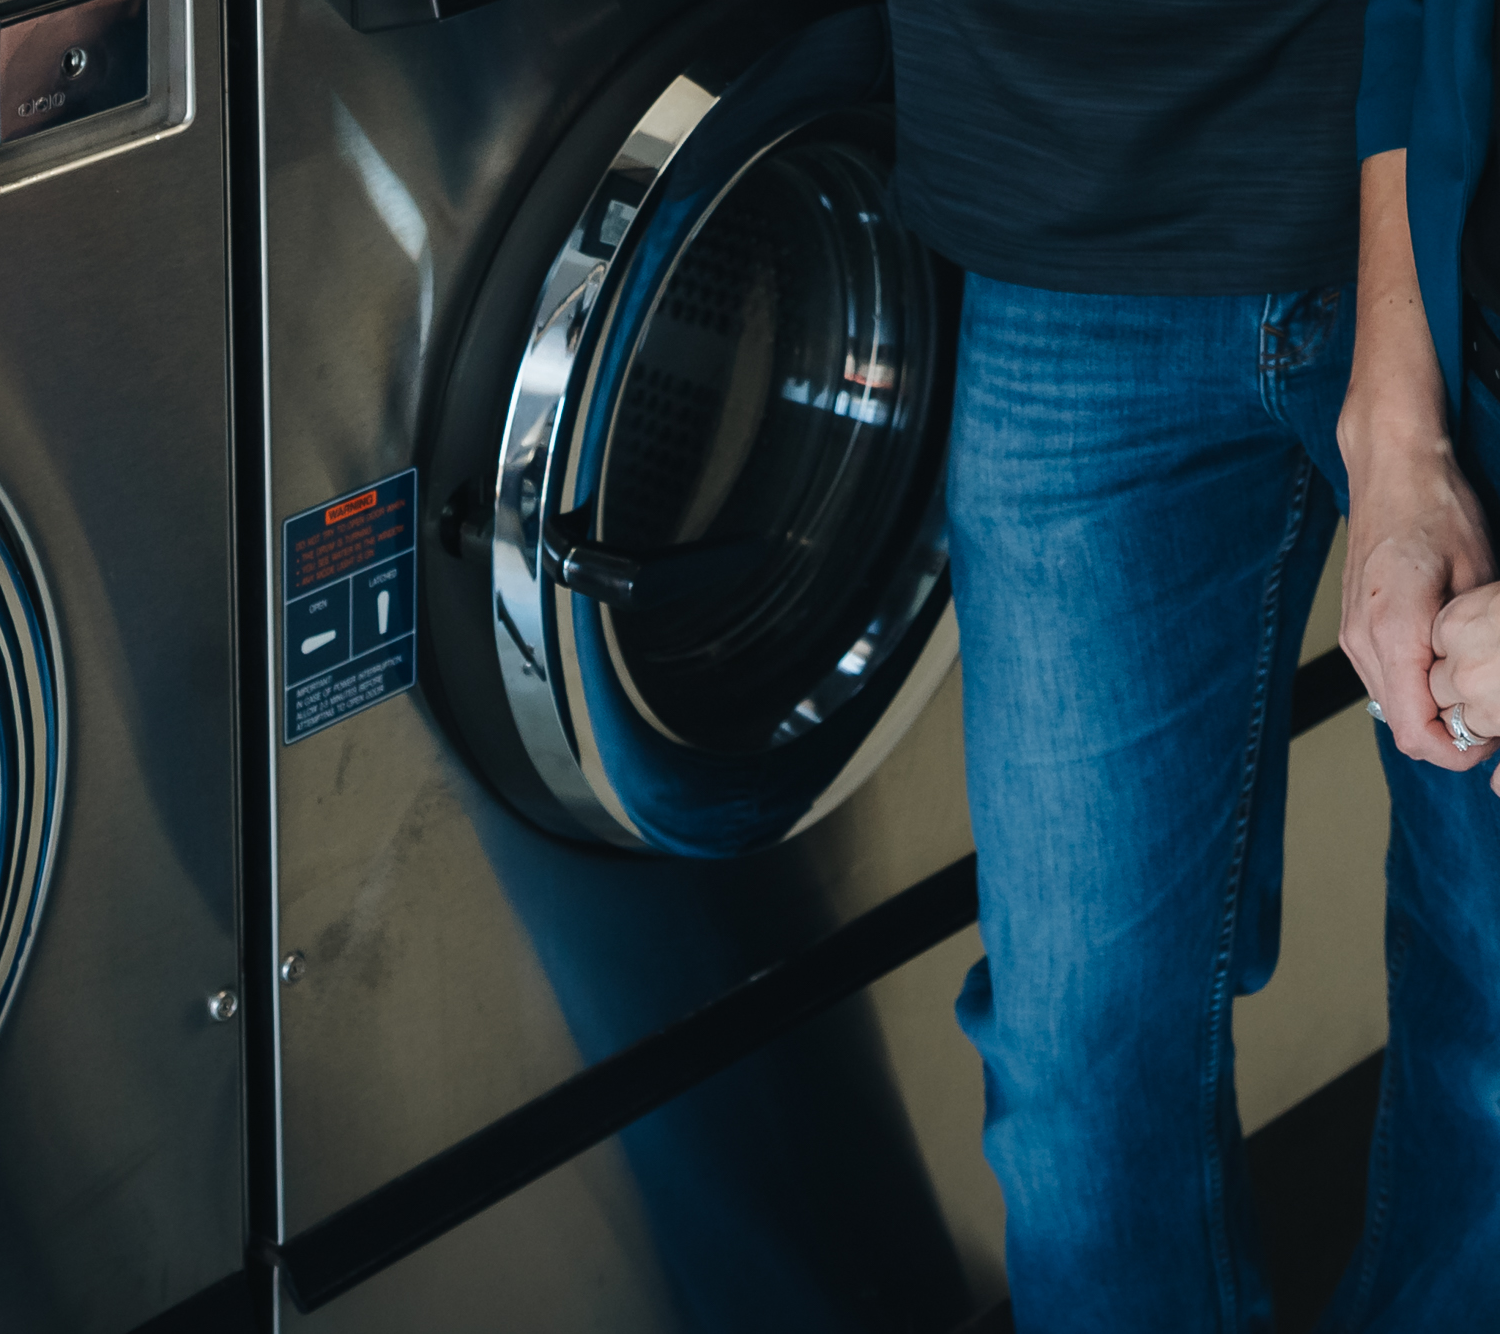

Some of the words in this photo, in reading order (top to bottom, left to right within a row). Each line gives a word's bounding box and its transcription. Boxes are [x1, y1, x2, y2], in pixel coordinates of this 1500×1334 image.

[328, 494, 373, 520] WARNING
[369, 568, 397, 588] LATCHED
[309, 599, 327, 614] OPEN
